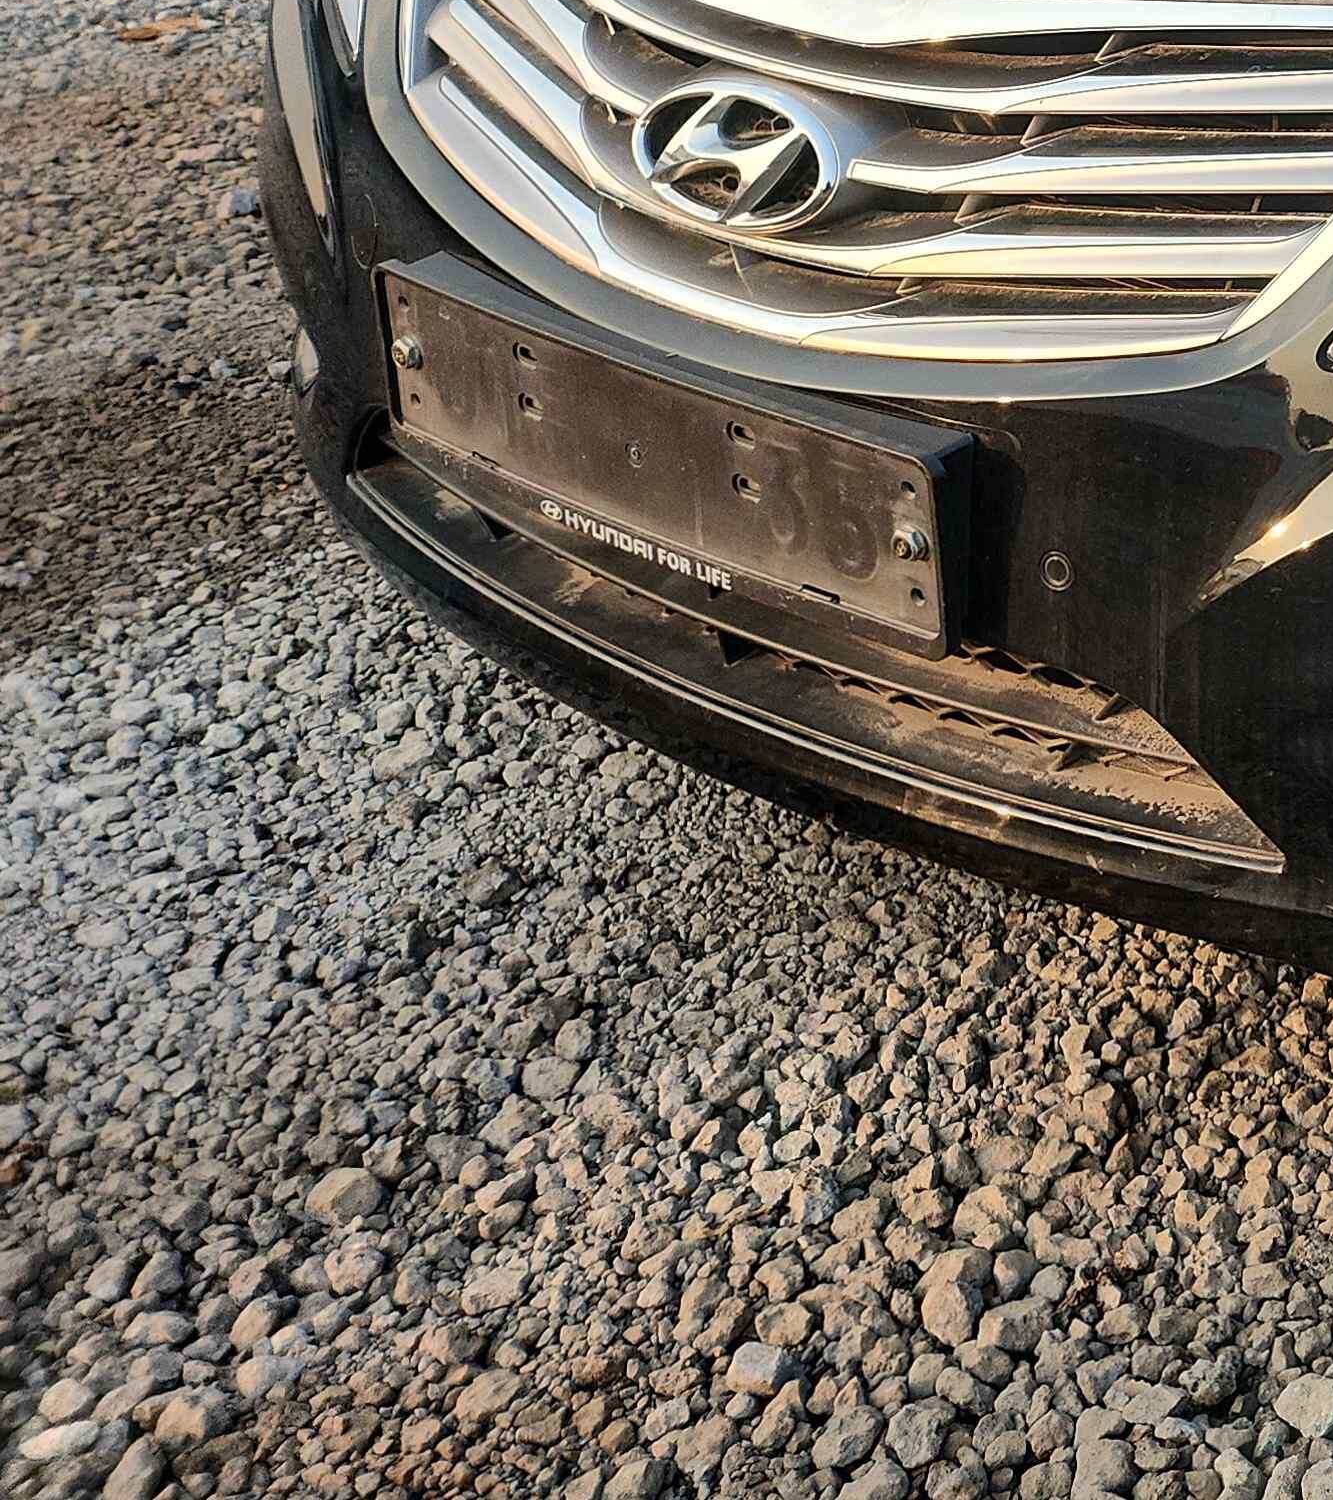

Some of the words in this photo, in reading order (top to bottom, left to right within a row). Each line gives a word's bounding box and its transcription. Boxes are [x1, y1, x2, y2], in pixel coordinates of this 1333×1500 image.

[564, 509, 655, 561] HYUNDAI
[657, 548, 692, 576] FOR
[695, 562, 733, 591] LIFE
